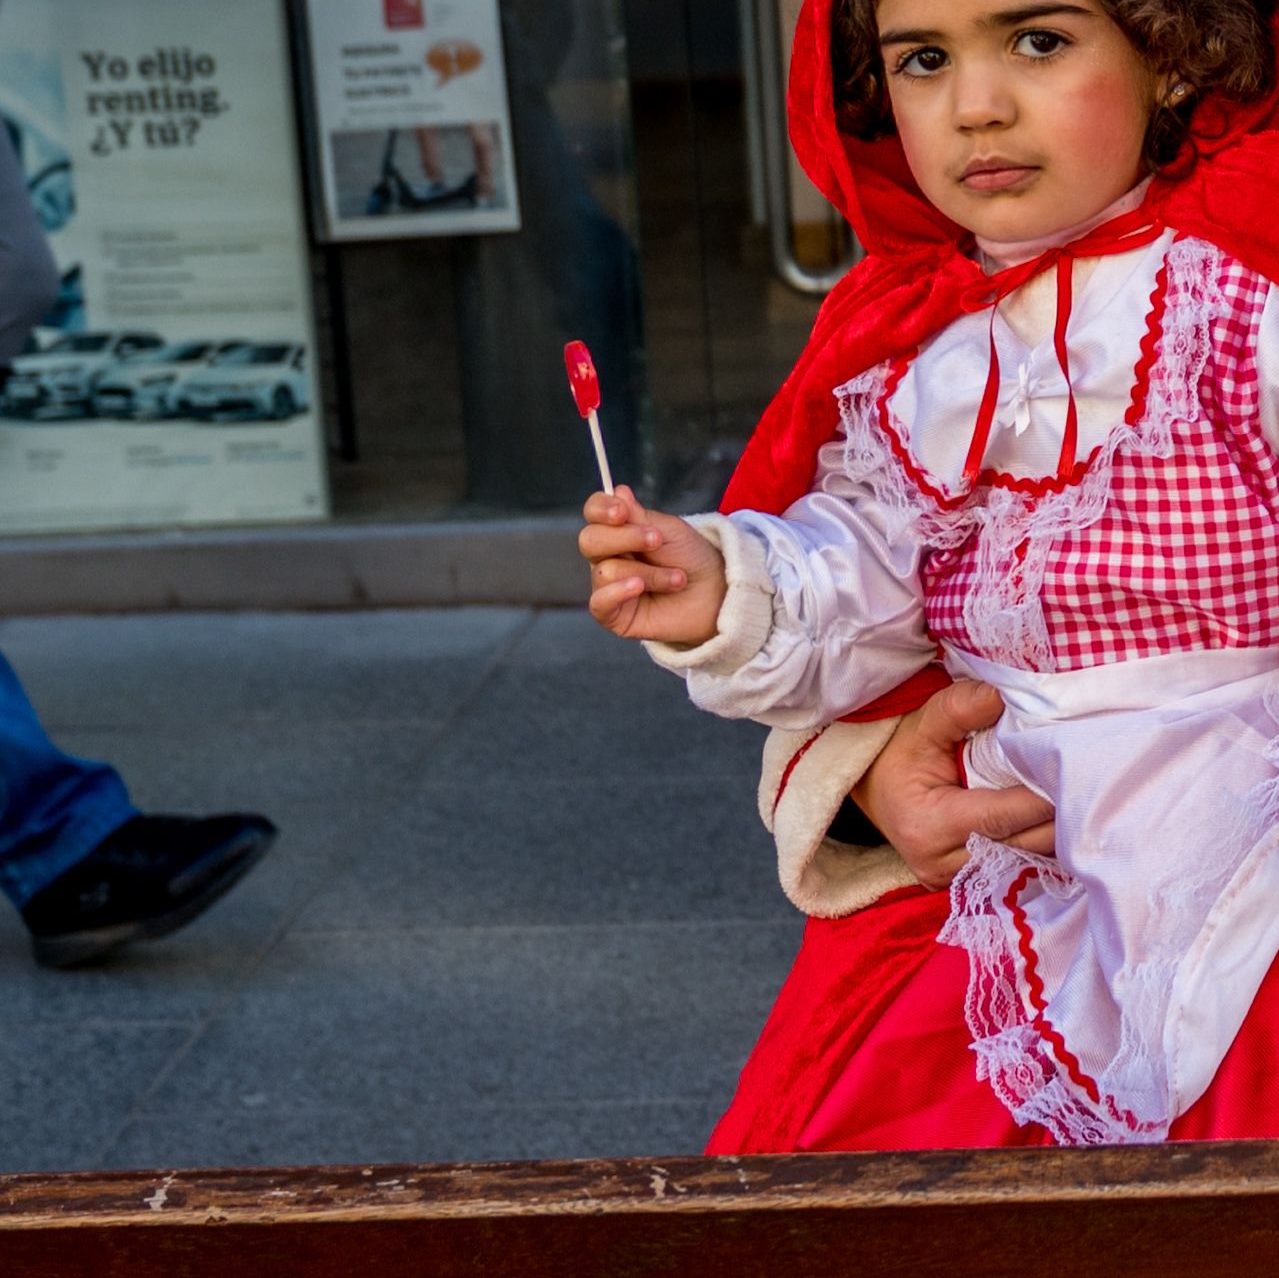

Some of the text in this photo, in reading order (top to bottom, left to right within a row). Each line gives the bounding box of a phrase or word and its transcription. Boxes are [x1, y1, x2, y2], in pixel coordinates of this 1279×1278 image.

[80, 45, 217, 85] Yo elijo
[86, 84, 231, 119] renting.
[89, 118, 133, 158] ¿Y
